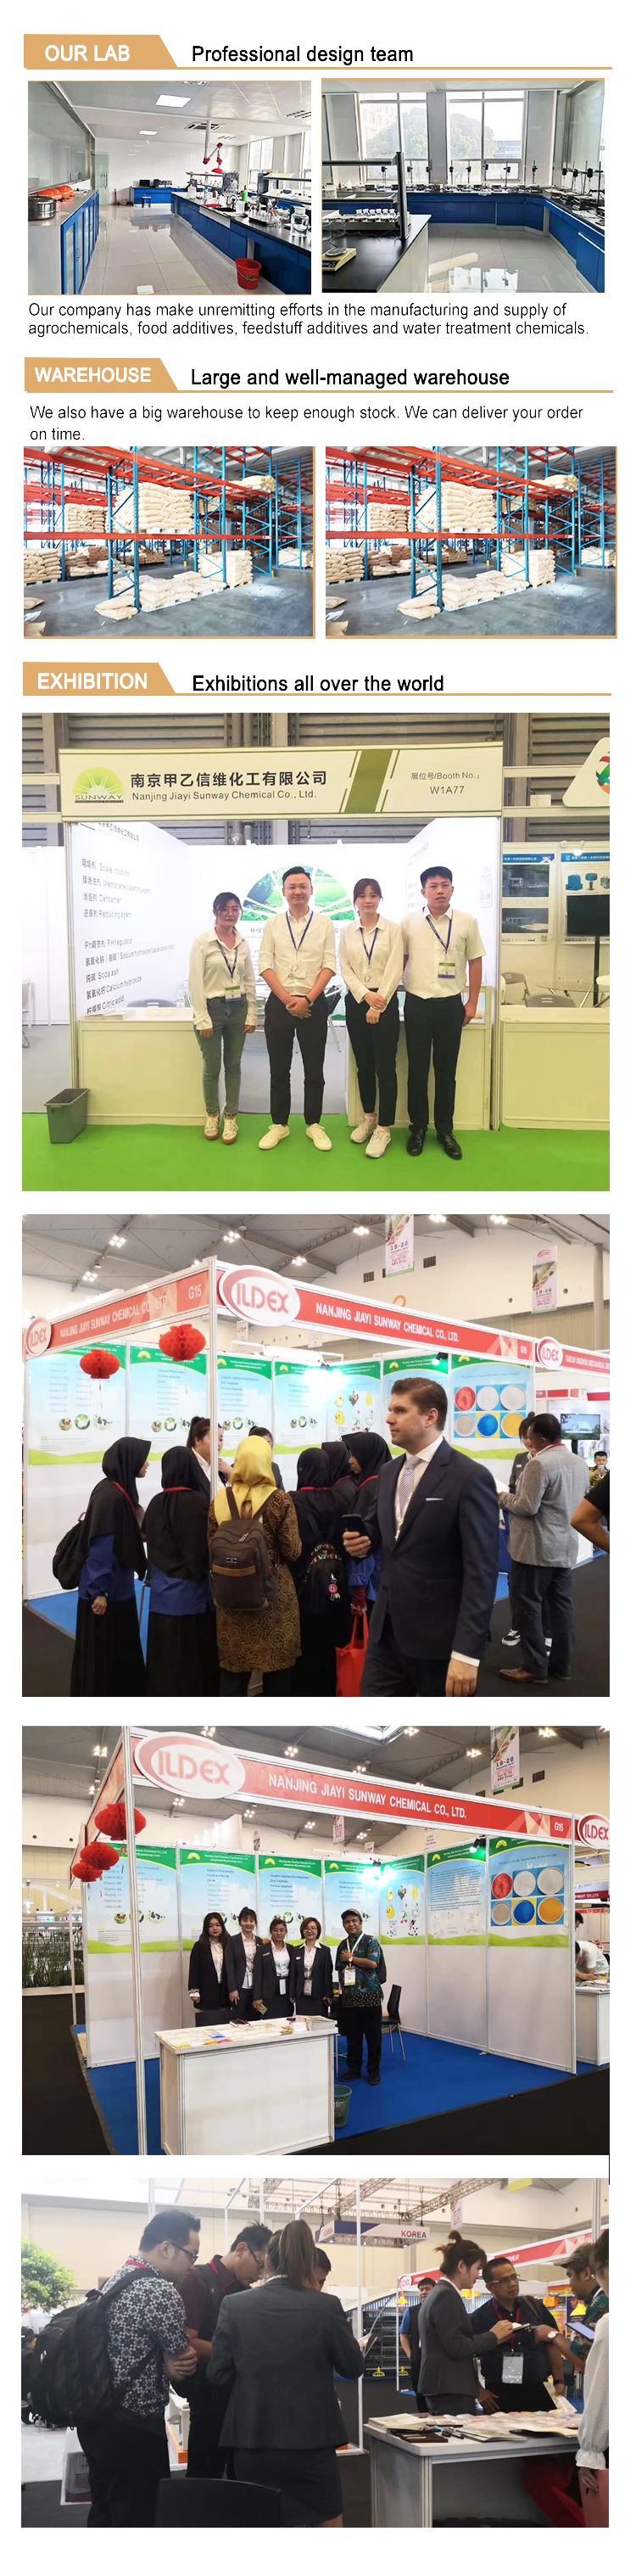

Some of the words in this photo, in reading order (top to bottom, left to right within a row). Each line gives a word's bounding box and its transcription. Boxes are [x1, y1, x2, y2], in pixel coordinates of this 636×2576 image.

[131, 770, 326, 788] 南京甲乙信维化工有限公司
[132, 792, 167, 803] Nanjing
[170, 791, 191, 802] Jiayi
[192, 791, 229, 801] Sunway
[232, 790, 275, 799] Chemical
[277, 790, 296, 799] Co.,
[298, 790, 316, 798] Ltd.
[429, 786, 465, 794] W1A77
[99, 894, 121, 904] Defoamer
[99, 910, 120, 920] Reducing
[98, 971, 110, 980] Soda
[111, 968, 120, 977] ash
[188, 1285, 202, 1300] G15
[237, 1282, 289, 1314] ILDEX
[60, 1324, 78, 1339] NANJING
[79, 1320, 90, 1334] JIAYI
[91, 1314, 111, 1330] SUNWAY
[112, 1305, 140, 1323] CHEMICAL
[316, 1302, 351, 1320] NANJING
[354, 1309, 371, 1325] JIAYI
[374, 1314, 401, 1330] SUNWAY
[404, 1321, 433, 1337] CHEMICAL
[28, 1327, 47, 1347] ILDEX
[541, 1347, 559, 1362] ILDEX
[158, 1750, 230, 1787] ILDEX
[496, 1756, 514, 1767] 18-20
[269, 1773, 317, 1794] NANJING
[321, 1784, 345, 1800] JIAYI
[349, 1787, 386, 1806] SUNWAY
[389, 1795, 432, 1813] CHEMICAL
[434, 1804, 449, 1817] CO.,
[451, 1806, 466, 1818] LTD.
[554, 1822, 564, 1832] G15
[584, 1824, 609, 1840] ILDEX
[401, 2230, 427, 2238] KOREA
